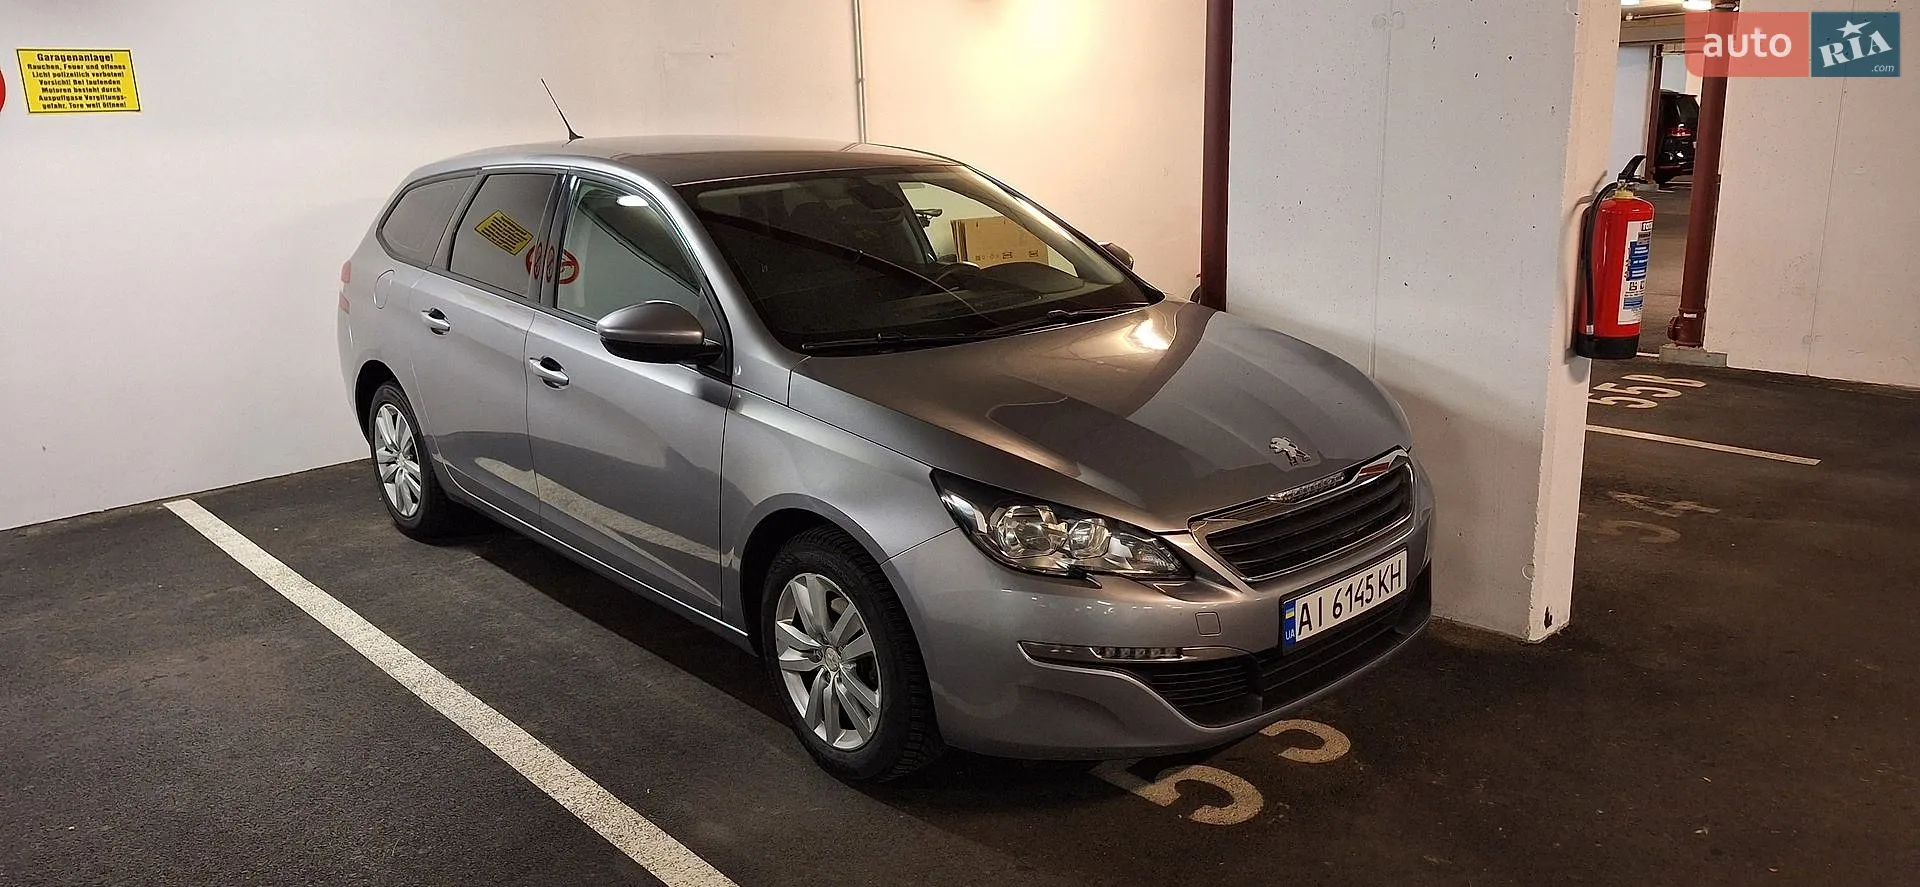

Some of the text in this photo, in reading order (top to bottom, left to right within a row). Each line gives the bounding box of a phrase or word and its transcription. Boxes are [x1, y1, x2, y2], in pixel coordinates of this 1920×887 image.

[37, 53, 114, 62] Garagenanlage!
[1297, 559, 1402, 636] AI 6145 KH
[1285, 630, 1295, 640] UA
